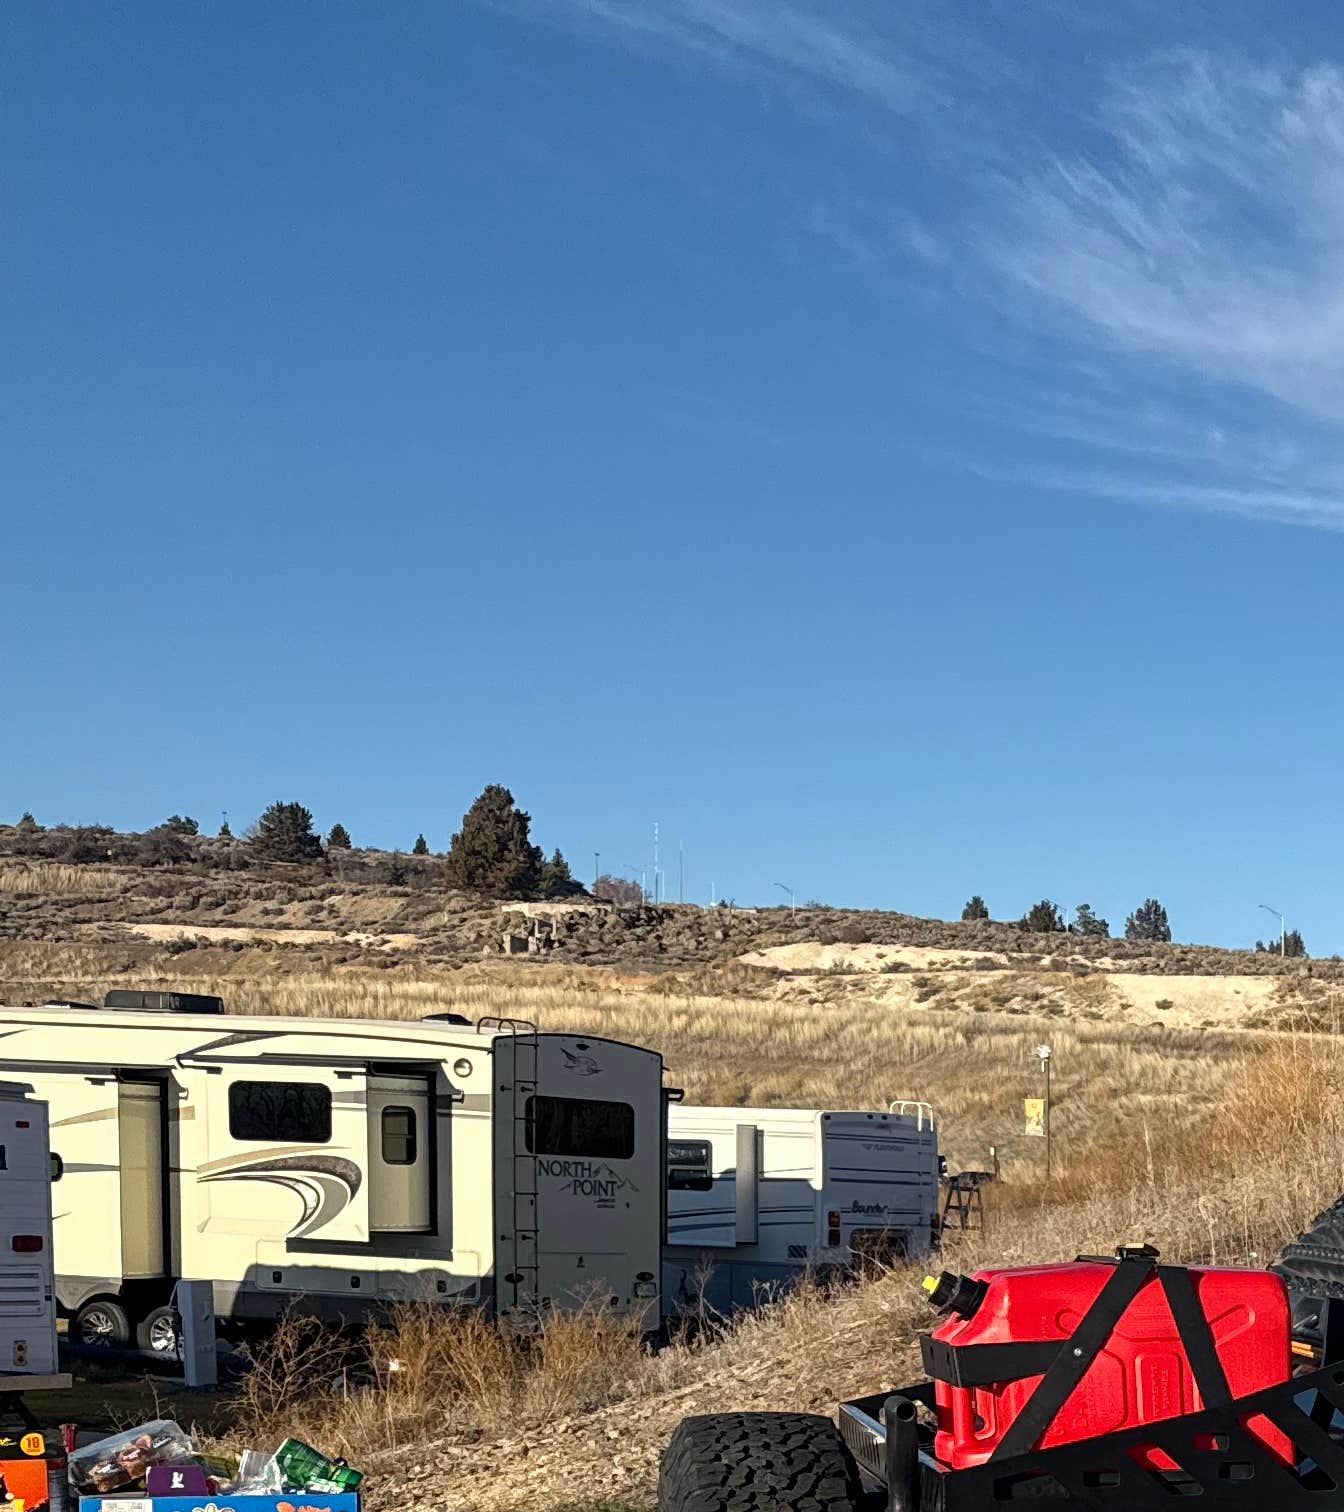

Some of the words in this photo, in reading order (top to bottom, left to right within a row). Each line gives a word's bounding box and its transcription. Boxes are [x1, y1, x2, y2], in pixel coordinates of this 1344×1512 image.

[537, 1160, 592, 1178] NORTH
[572, 1179, 617, 1196] POINT
[25, 1436, 40, 1449] 18
